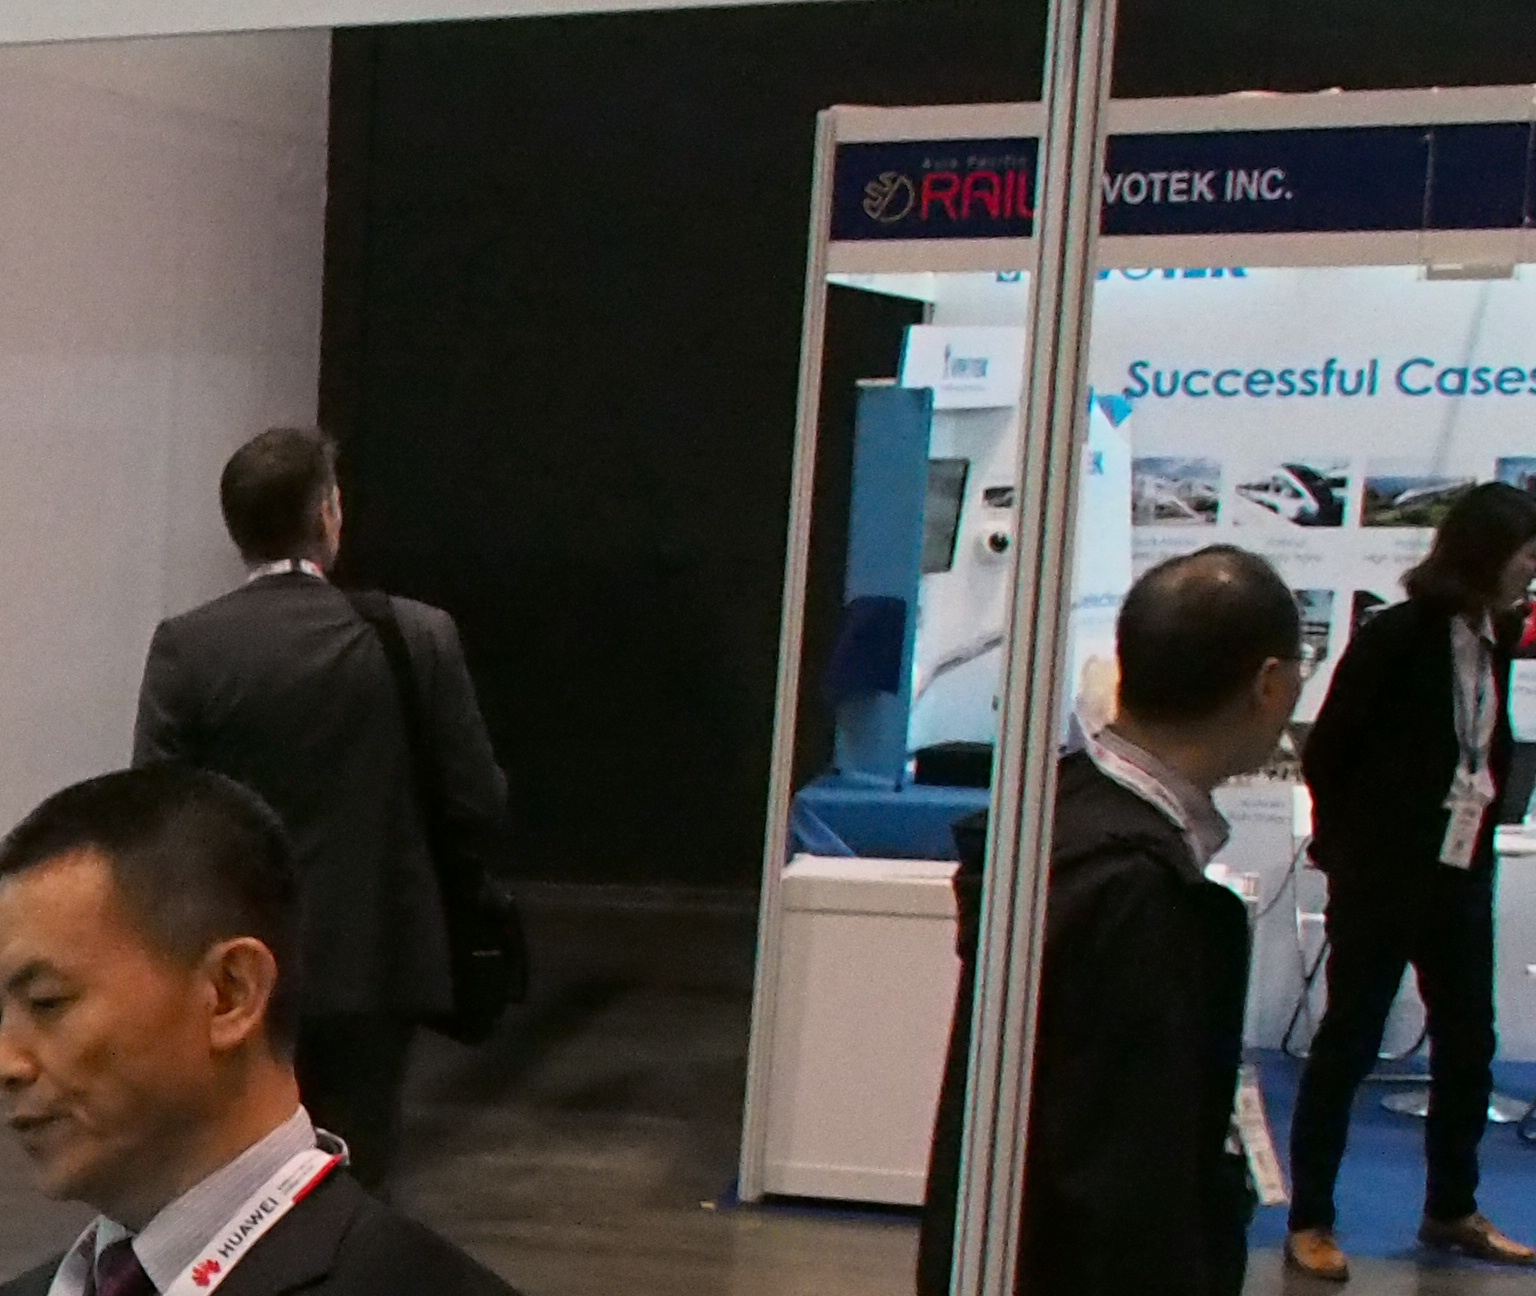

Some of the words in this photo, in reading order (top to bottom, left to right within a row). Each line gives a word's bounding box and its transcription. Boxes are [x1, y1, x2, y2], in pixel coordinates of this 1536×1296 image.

[921, 169, 1035, 221] RAIL
[1225, 166, 1294, 201] INC.
[1127, 357, 1379, 399] Successful
[218, 1196, 279, 1258] HUAWEI
